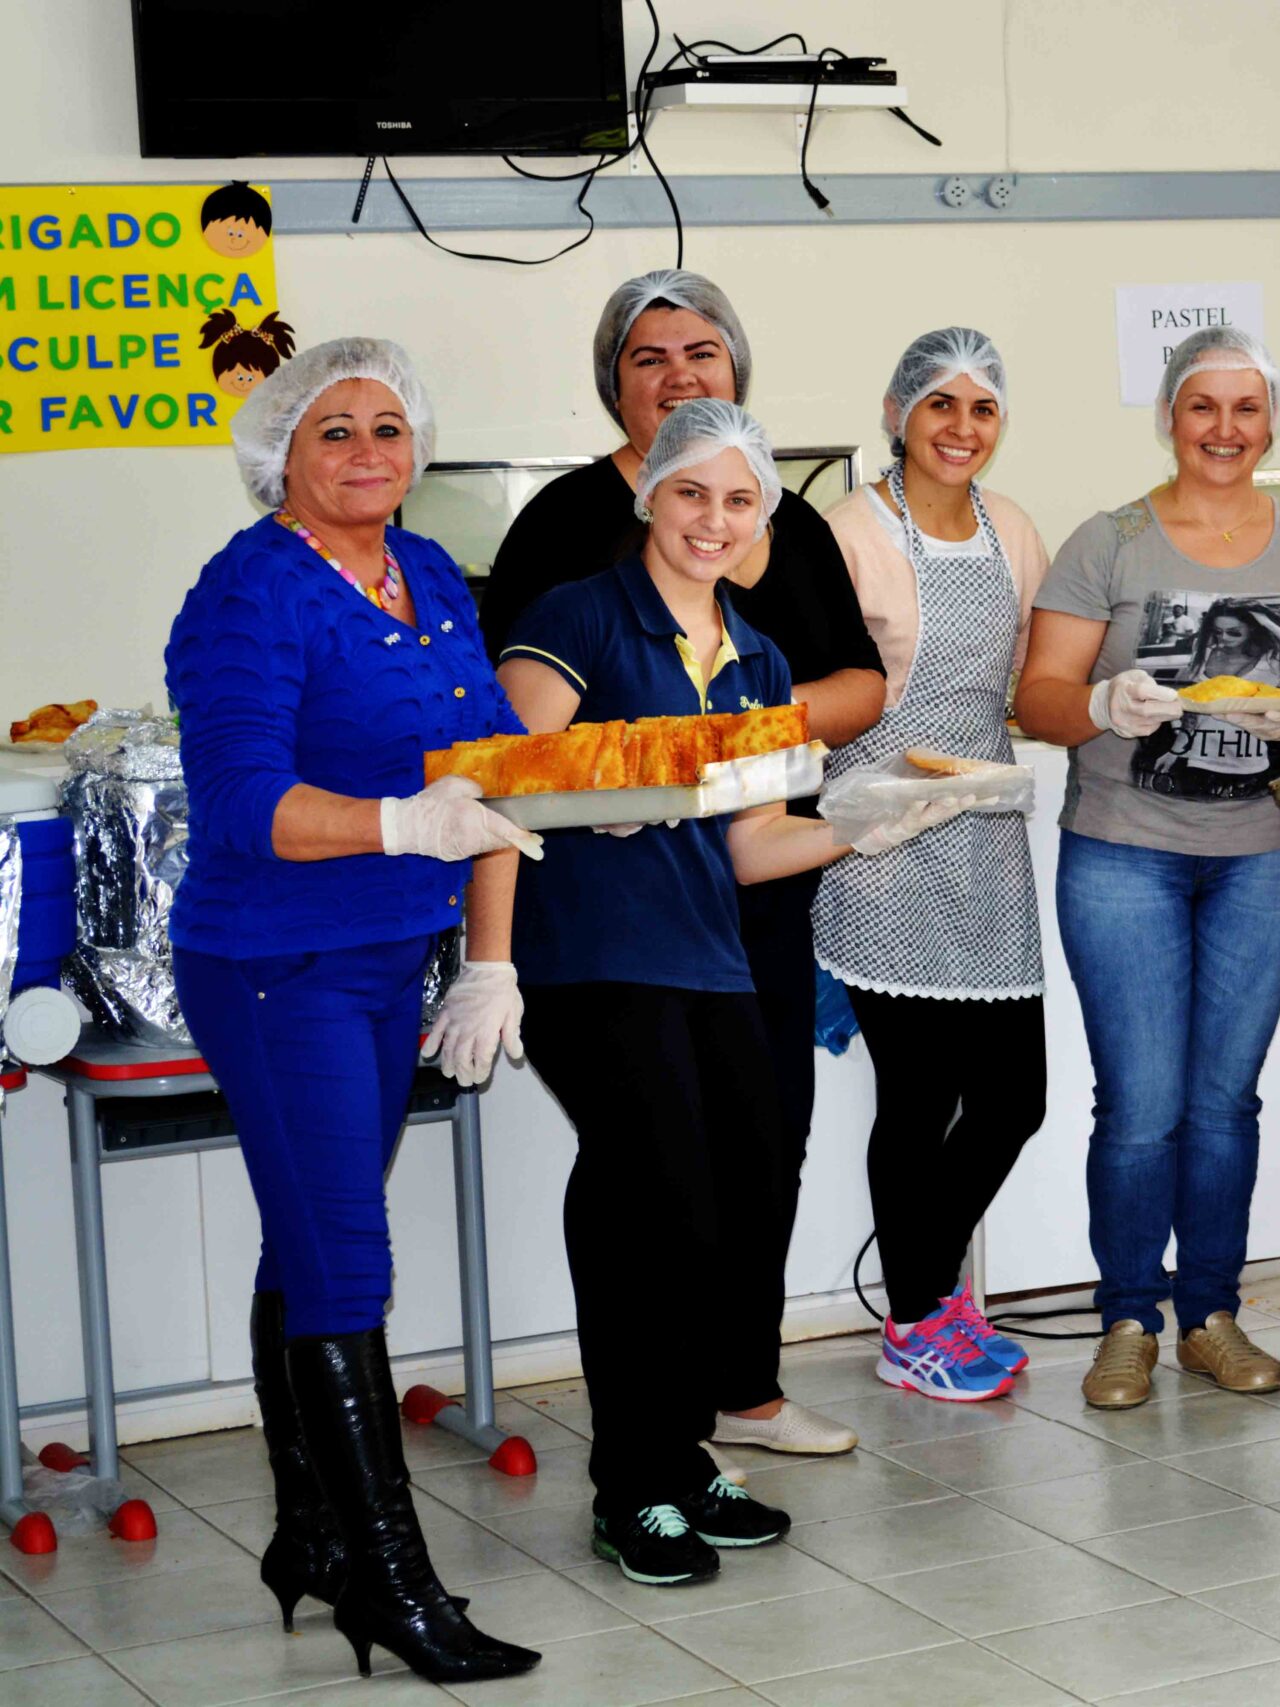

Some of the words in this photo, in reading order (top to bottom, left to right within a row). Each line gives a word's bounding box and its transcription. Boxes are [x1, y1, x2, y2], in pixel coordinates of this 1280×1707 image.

[376, 121, 412, 129] TOSHIBA
[0, 212, 181, 250] IGADO
[38, 273, 263, 314] LICENÇA
[1151, 307, 1232, 329] PASTEL
[0, 333, 181, 372] CULPE
[40, 393, 218, 432] FAVOR
